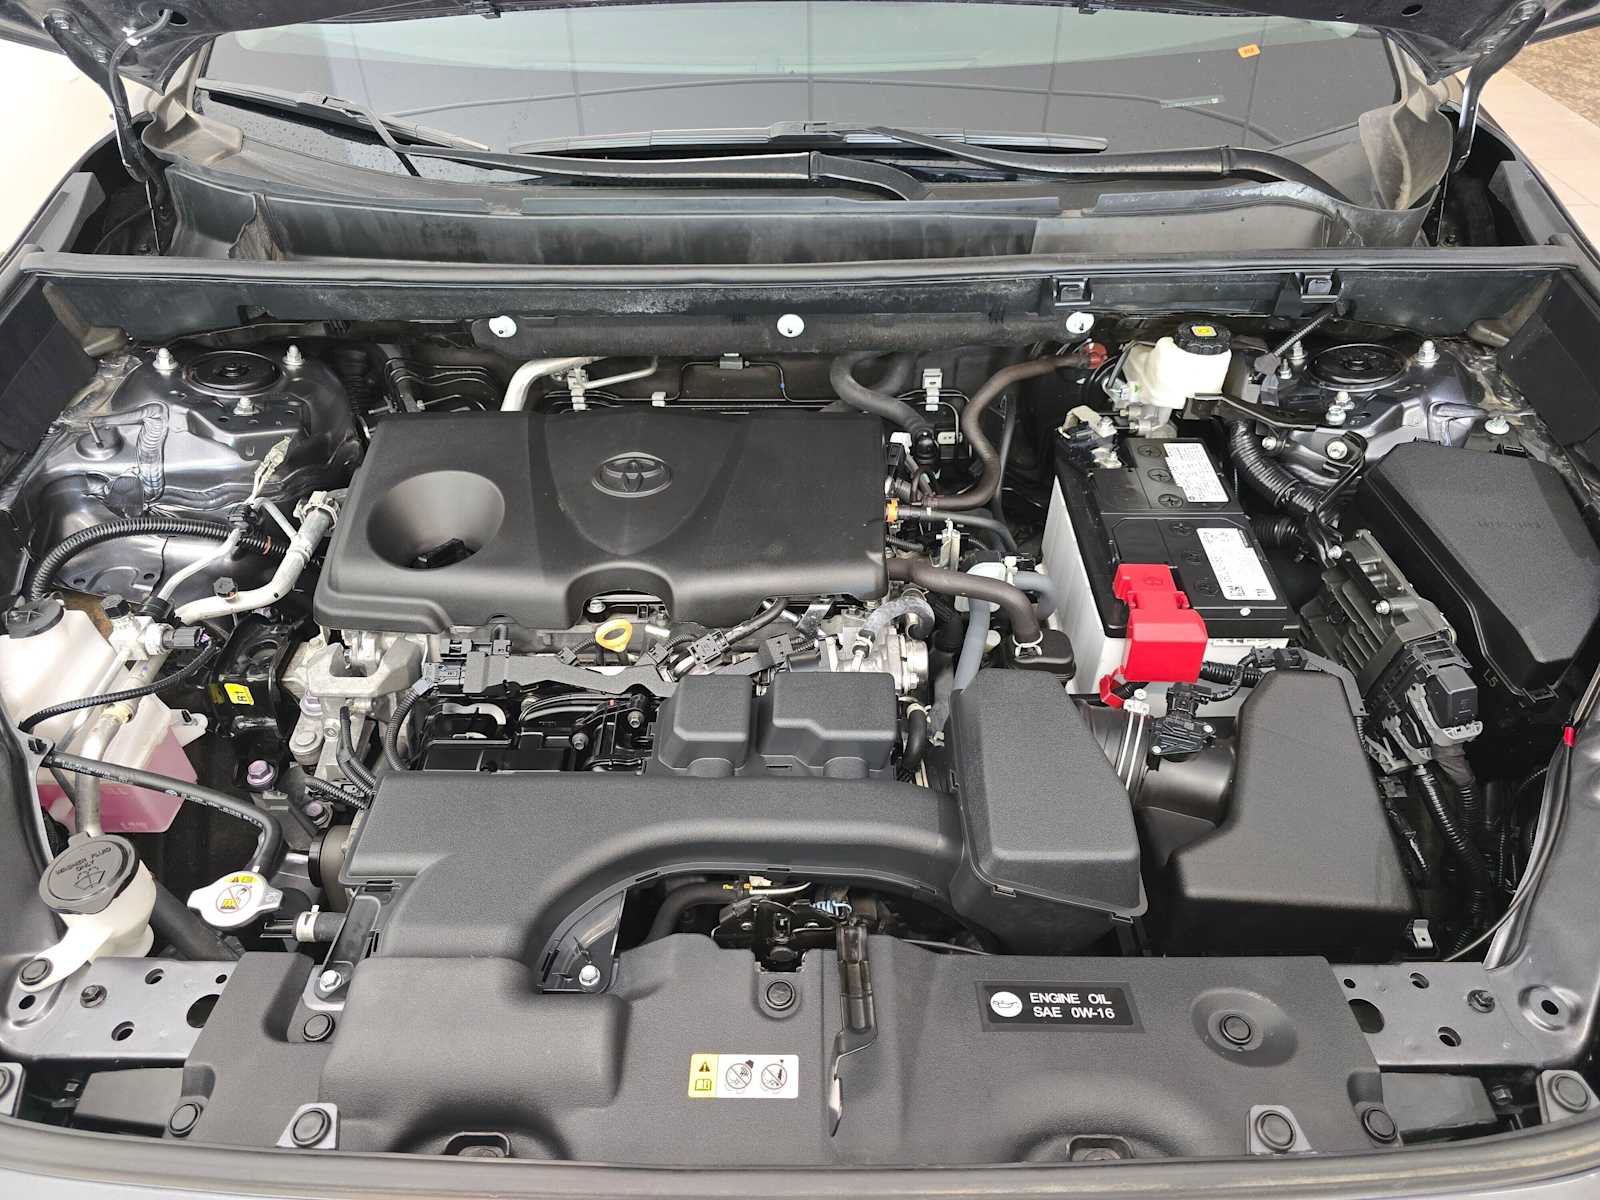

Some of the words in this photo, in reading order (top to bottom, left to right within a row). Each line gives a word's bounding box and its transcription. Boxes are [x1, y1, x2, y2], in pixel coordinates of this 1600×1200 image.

[1029, 992, 1080, 1004] ENGINE
[1088, 993, 1112, 1005] OIL
[1033, 1006, 1063, 1018] SAE
[1071, 1007, 1115, 1019] 0W-16
